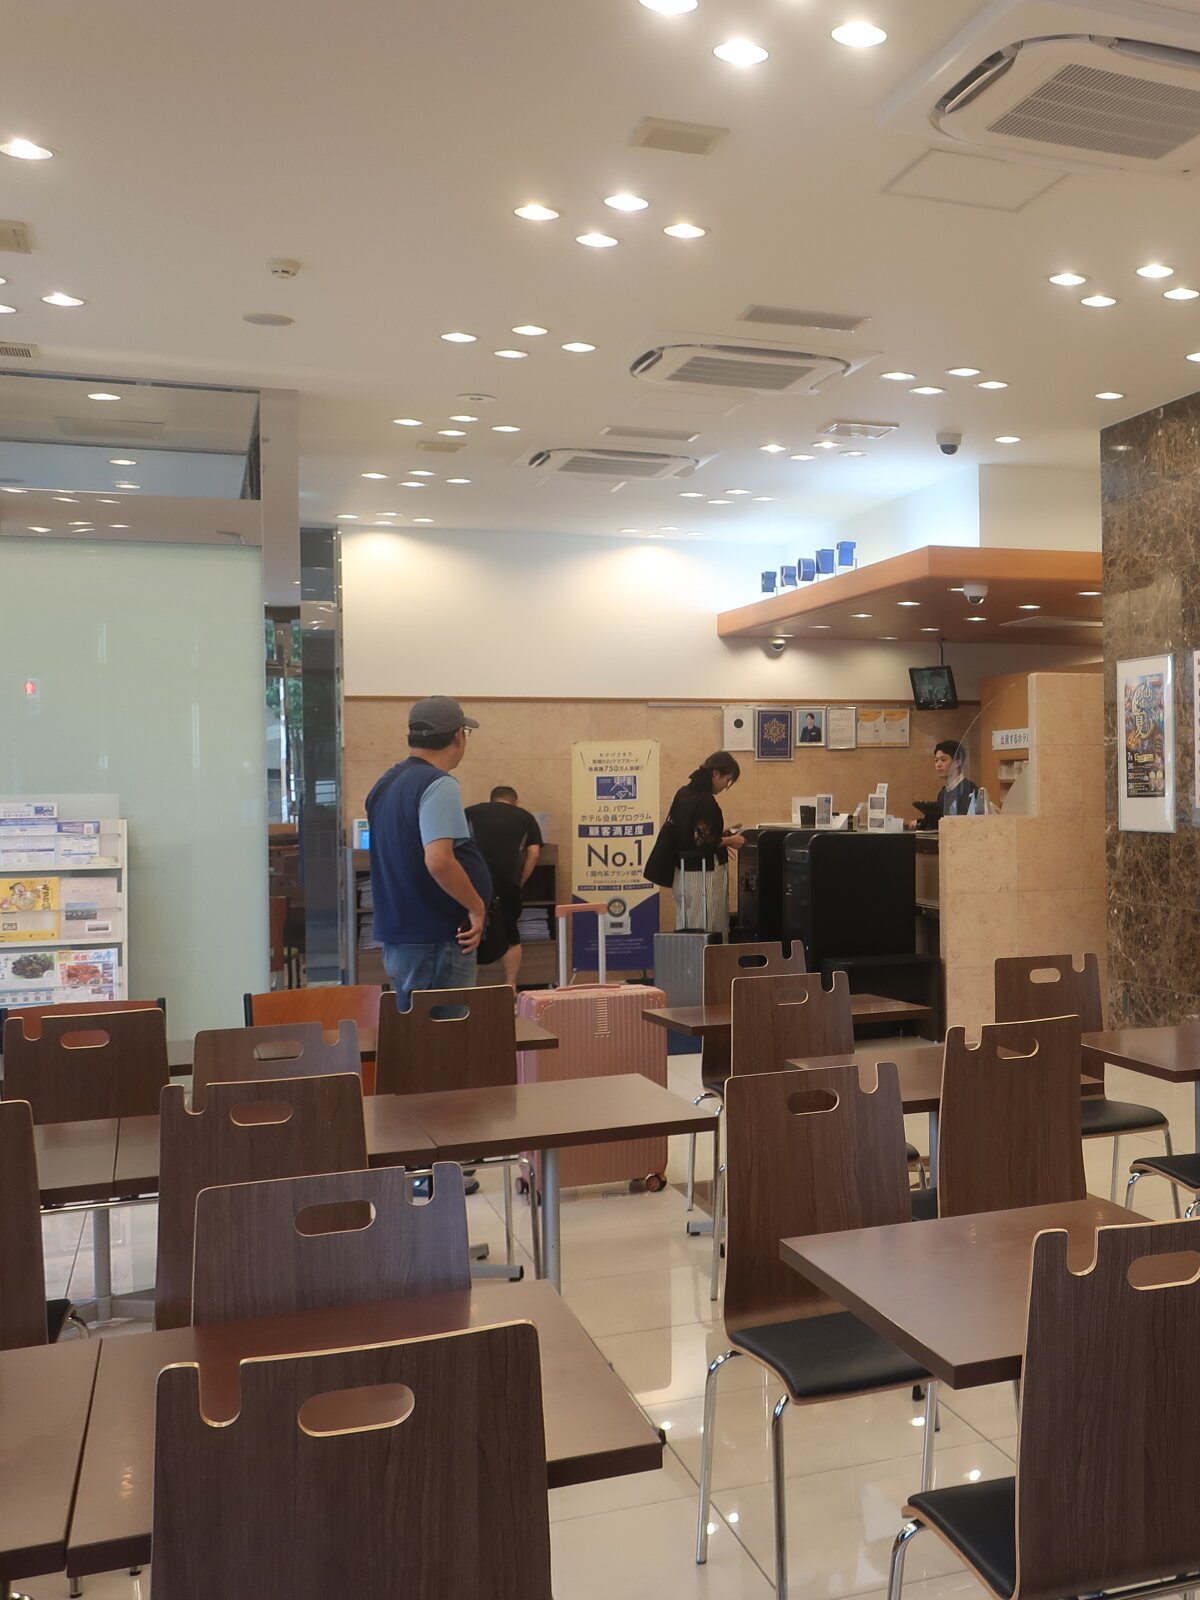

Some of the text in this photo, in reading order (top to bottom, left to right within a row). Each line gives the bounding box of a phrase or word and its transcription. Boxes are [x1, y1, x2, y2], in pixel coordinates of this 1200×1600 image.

[580, 813, 652, 822] ホテル会員プログラム
[588, 825, 644, 836] 顧客満足度
[587, 839, 642, 868] No.1
